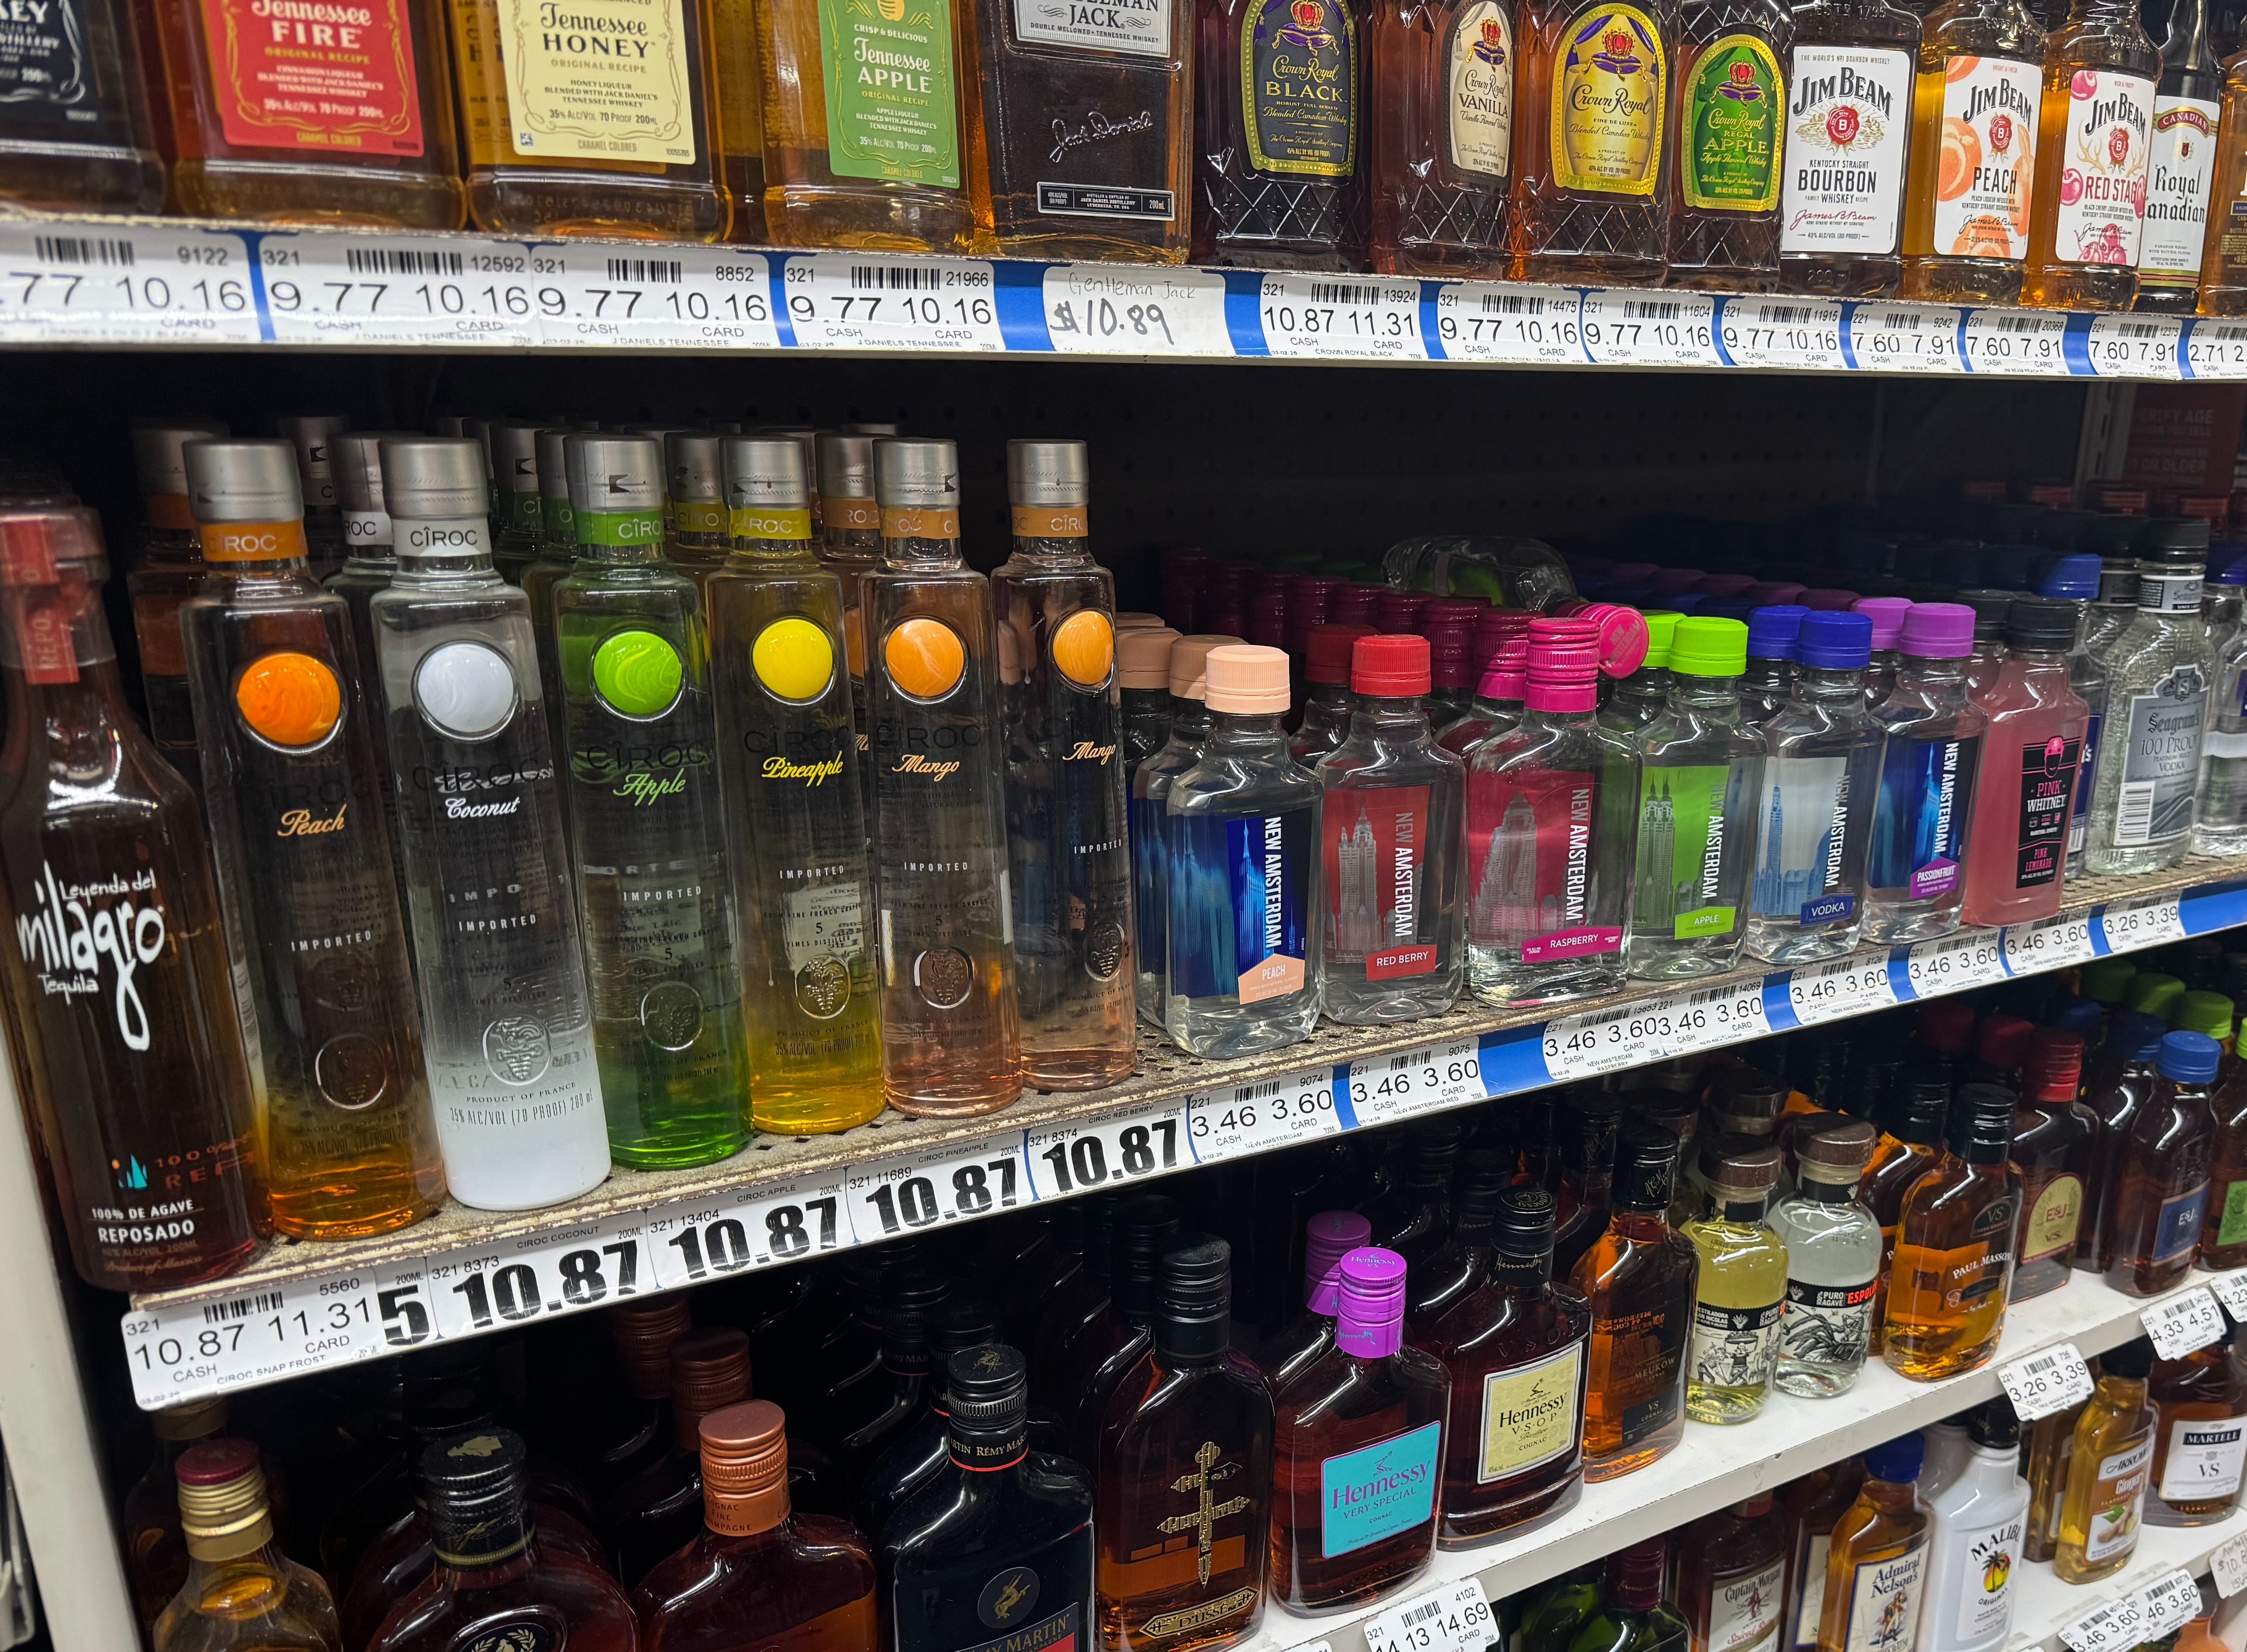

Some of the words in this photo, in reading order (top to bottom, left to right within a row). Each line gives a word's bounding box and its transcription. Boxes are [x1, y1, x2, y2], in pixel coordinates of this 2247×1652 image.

[541, 2, 648, 35] Tennessee
[1069, 8, 1121, 28] JACK
[272, 21, 362, 49] FIRE
[854, 24, 878, 35] CRISP
[887, 29, 927, 43] DELICIOUS
[1030, 22, 1055, 31] DOUBLE
[1057, 25, 1091, 35] MELLOWED
[1096, 30, 1132, 40] TENNESSEE
[1133, 35, 1159, 43] WHISKEY
[543, 33, 648, 59] HONEY
[853, 37, 931, 72] Tennessee
[551, 59, 605, 71] ORIGINAL
[609, 63, 647, 74] RECIPE
[1273, 56, 1309, 80] Crown
[1305, 59, 1340, 83] Royal
[857, 67, 931, 94] APPLE
[1265, 81, 1346, 102] BLACK
[1793, 75, 1835, 115] JIM
[1840, 67, 1891, 120] BEAM
[562, 96, 607, 105] TENNESSEE
[609, 99, 643, 108] WHISKEY
[1458, 92, 1509, 119] VANILLA
[1708, 109, 1737, 129] Crown
[1738, 112, 1764, 130] Royal
[2085, 101, 2115, 136] JIM
[2118, 92, 2146, 144] BEAM
[2162, 112, 2208, 133] CANADIAN
[1703, 140, 1767, 154] APPLE
[1724, 130, 1754, 139] REGAL
[1809, 159, 1839, 169] KENTUCKY
[1841, 160, 1869, 170] STRAIGHT
[1798, 170, 1877, 194] BOURBON
[1973, 167, 2017, 195] PEACH
[2085, 176, 2111, 201] RED
[2113, 178, 2138, 203] STAG
[2155, 164, 2200, 202] Royal
[1822, 193, 1854, 204] WHISKEY
[2147, 196, 2205, 224] anadian
[1068, 272, 1152, 296] Gentleman
[1162, 276, 1195, 299] Jack
[1263, 283, 1284, 297] 321
[1383, 289, 1417, 303] 13924
[270, 281, 387, 313] 9.77
[415, 284, 528, 317] 10.16
[578, 323, 618, 334] CASH
[702, 327, 744, 337] CARD
[1049, 298, 1174, 346] $10.89
[1265, 307, 1334, 333] 10.87
[1348, 311, 1414, 337] 11.31
[1440, 317, 1502, 342] 9.77
[1516, 321, 1577, 344] 10.16
[1315, 348, 1343, 356] CROWN
[1345, 349, 1368, 357] ROYAL
[2090, 340, 2129, 360] 7.60
[2139, 342, 2176, 362] 7.91
[2190, 345, 2224, 362] 2.71
[410, 528, 477, 547] CÎROC
[2147, 709, 2200, 735] Seagram's
[1063, 741, 1116, 765] Mango
[1943, 742, 1960, 772] NEW
[761, 751, 843, 788] Pineapple
[892, 754, 960, 782] Mango
[613, 768, 687, 807] Apple
[2036, 782, 2062, 798] PINK
[445, 796, 521, 818] Coconut
[1933, 772, 1956, 853] AMSTERDAM
[2027, 794, 2066, 812] WHITNEY
[277, 803, 348, 837] Peach
[1396, 812, 1413, 843] NEW
[1265, 816, 1281, 851] NEW
[905, 862, 969, 872] IMPORTED
[1917, 865, 1956, 882] PASSIONFRUIT
[2025, 857, 2052, 871] LEMONADE
[60, 873, 129, 905] Leyenda
[133, 867, 156, 890] del
[1395, 846, 1413, 937] AMSTERDAM
[1265, 853, 1282, 949] AMSTERDAM
[1811, 903, 1845, 916] VODKA
[459, 914, 537, 931] IMPORTED
[1694, 914, 1719, 925] APPLE
[2105, 915, 2138, 935] 3.26
[2146, 906, 2178, 926] 3.39
[291, 930, 372, 952] IMPORTED
[1550, 933, 1599, 949] RASPBERRY
[16, 858, 164, 1051] milagro
[1377, 956, 1396, 967] RED
[1399, 951, 1428, 964] BERRY
[1262, 964, 1286, 980] PEACH
[37, 973, 98, 1005] Tequila
[1792, 981, 1835, 1004] 3.46
[1846, 970, 1888, 992] 3.60
[466, 1094, 516, 1103] PRODUCT
[521, 1091, 535, 1100] OF
[539, 1081, 576, 1097] FRANCE
[1191, 1097, 1210, 1109] 221
[1300, 1074, 1323, 1087] 9074
[1352, 1074, 1410, 1103] 3.46
[1423, 1059, 1479, 1087] 3.60
[1088, 1114, 1111, 1124] CIROC
[1113, 1110, 1128, 1119] RED
[1129, 1104, 1153, 1117] BERRY
[1163, 1108, 1181, 1119] 200ML
[1191, 1105, 1256, 1137] 3.46
[1271, 1090, 1332, 1118] 3.60
[918, 1153, 943, 1163] CIROC
[946, 1142, 989, 1158] PINEAPPLE
[1001, 1145, 1021, 1156] 200ML
[1042, 1118, 1177, 1191] 10.87
[737, 1192, 765, 1203] CIROC
[768, 1184, 796, 1197] APPLE
[820, 1184, 842, 1196] 200ML
[865, 1157, 1016, 1234] 10.87
[92, 1207, 123, 1220] 100%
[129, 1207, 146, 1218] DE
[150, 1199, 194, 1217] AGAVE
[98, 1220, 195, 1244] REPOSADO
[517, 1237, 549, 1249] CIROC
[551, 1226, 600, 1242] COCONUT
[619, 1228, 643, 1240] 200ML
[669, 1196, 837, 1281] 10.87
[1351, 1255, 1395, 1268] Hennessy
[1953, 1262, 1979, 1279] PAUL
[1981, 1252, 2012, 1269] MASSON
[396, 1271, 423, 1284] 200ML
[452, 1240, 637, 1330] 10.87
[126, 1320, 159, 1335] 321
[320, 1278, 360, 1296] 5560
[1822, 1299, 1843, 1308] AGAVE
[1823, 1291, 1844, 1300] PURO
[134, 1324, 245, 1370] 10.87
[268, 1298, 370, 1342] 11.31
[2152, 1320, 2184, 1342] 4.33
[2189, 1306, 2219, 1327] 4.51
[218, 1370, 253, 1385] CIROC
[257, 1363, 286, 1378] SNAP
[289, 1355, 325, 1370] FROST
[1633, 1355, 1676, 1382] MEUKOW
[2009, 1379, 2047, 1403] 3.26
[2051, 1361, 2087, 1386] 3.39
[1498, 1392, 1567, 1428] Hennessy
[1518, 1437, 1547, 1451] COGNAC
[2187, 1428, 2238, 1444] MARTELL
[977, 1446, 1005, 1456] RÉMY
[2115, 1472, 2141, 1495] Ginger
[2199, 1463, 2220, 1478] VS
[1332, 1459, 1431, 1509] Hennessy
[1343, 1502, 1368, 1519] VERY
[1372, 1486, 1416, 1509] SPECIAL
[1369, 1511, 1392, 1523] COGNAC
[1873, 1552, 1920, 1584] Admiral
[1455, 1587, 1476, 1601] 4102
[1871, 1573, 1918, 1599] Nelson's
[1437, 1602, 1488, 1638] 14.69
